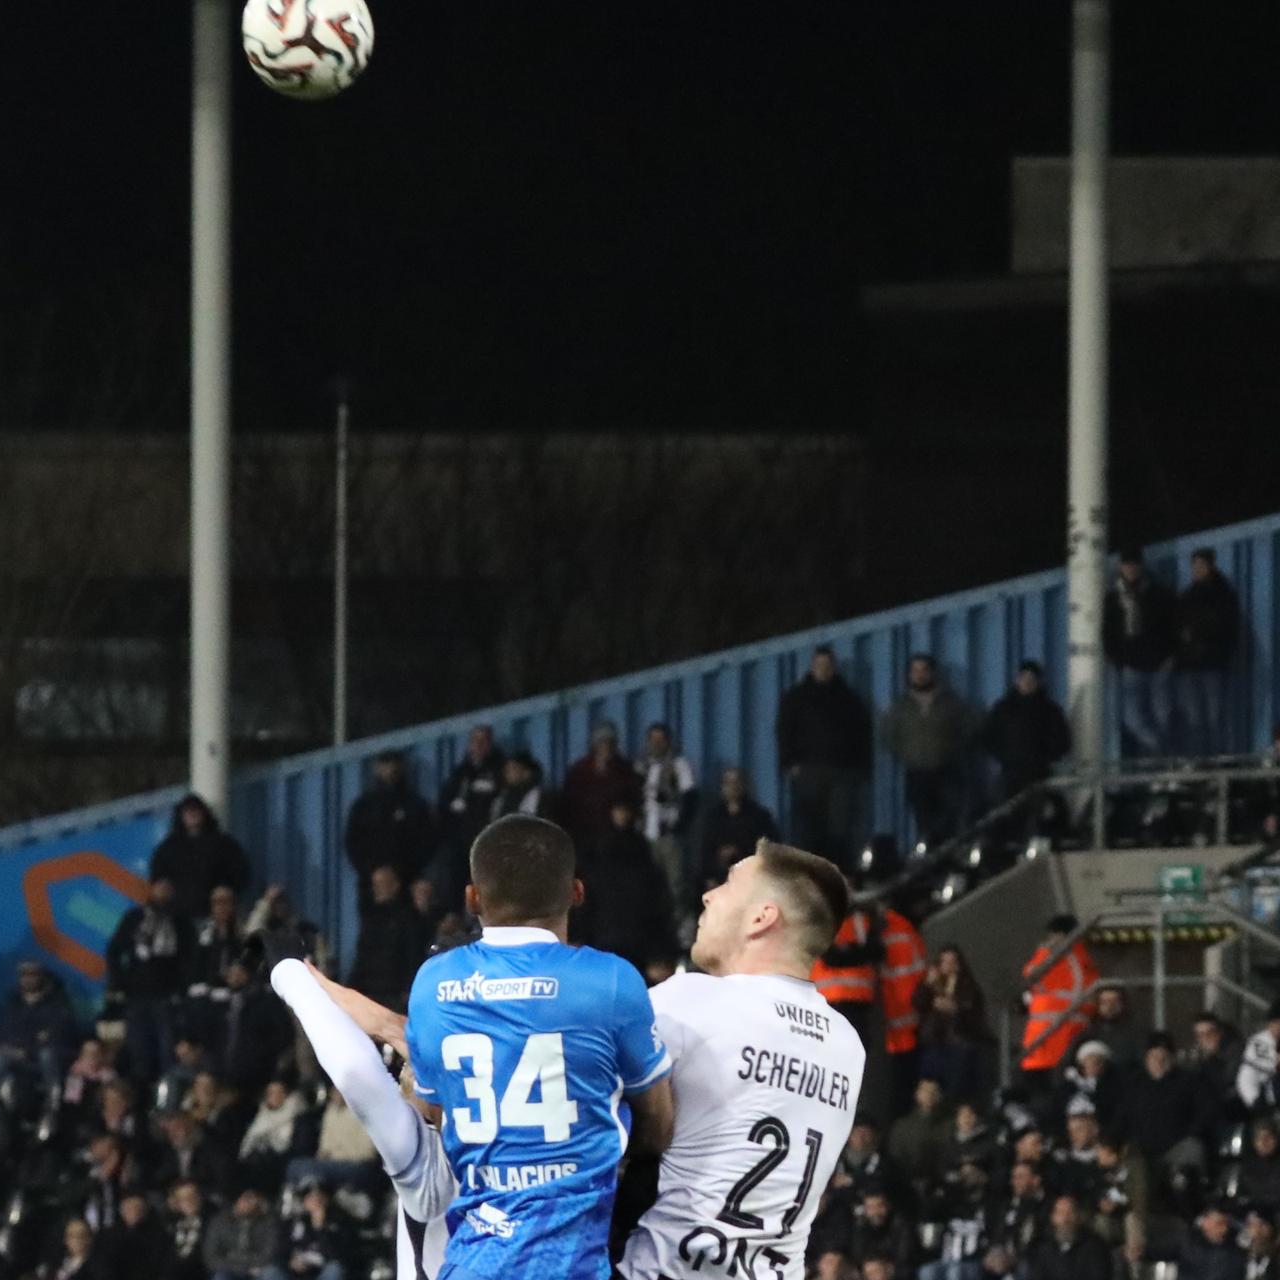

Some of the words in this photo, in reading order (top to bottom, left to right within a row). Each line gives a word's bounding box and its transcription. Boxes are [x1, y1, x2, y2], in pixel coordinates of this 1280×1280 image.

[485, 981, 528, 995] SPORT
[533, 981, 554, 994] TV
[775, 1002, 831, 1033] UNIBET
[441, 1032, 578, 1144] 34
[738, 1045, 850, 1112] SCHEIDLER
[715, 1116, 823, 1239] 21
